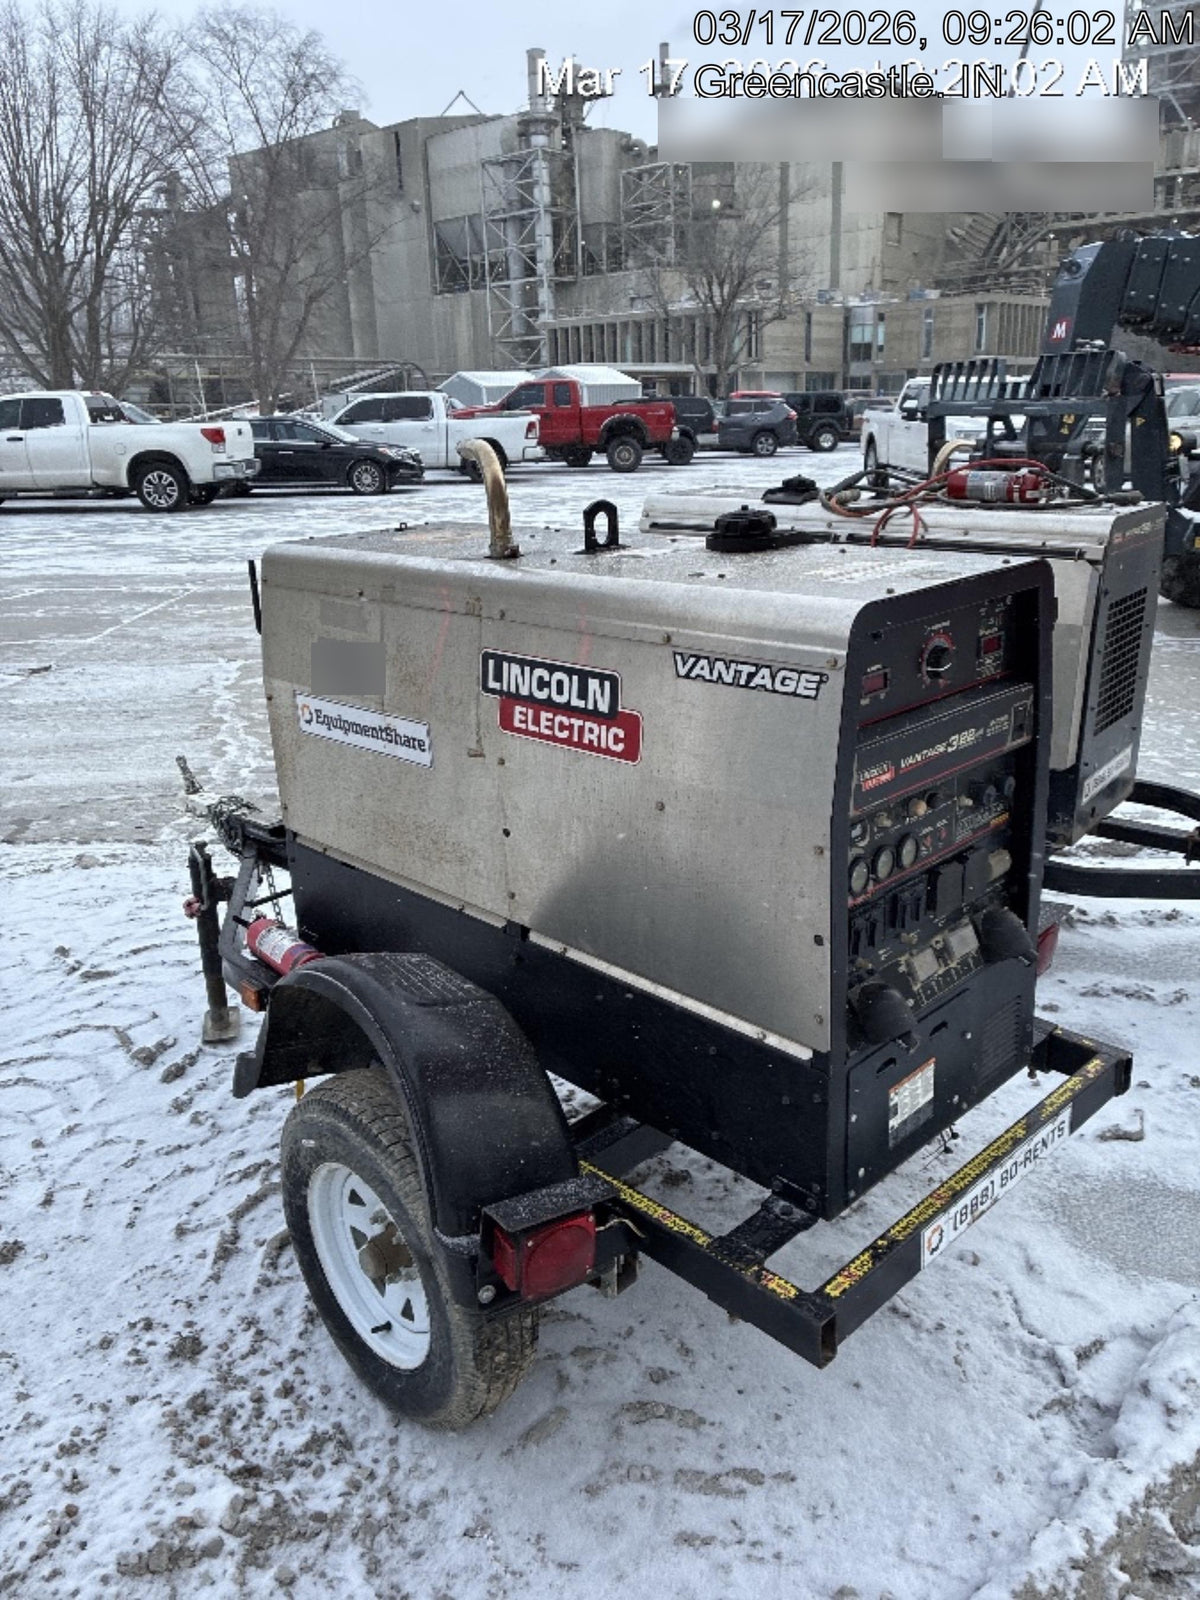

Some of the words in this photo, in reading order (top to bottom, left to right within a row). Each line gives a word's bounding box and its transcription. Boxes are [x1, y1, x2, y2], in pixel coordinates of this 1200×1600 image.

[488, 659, 611, 714] LINCOLN
[674, 652, 822, 699] VANTAGE
[314, 709, 426, 753] EquipmentShare
[513, 705, 625, 753] ELECTRIC
